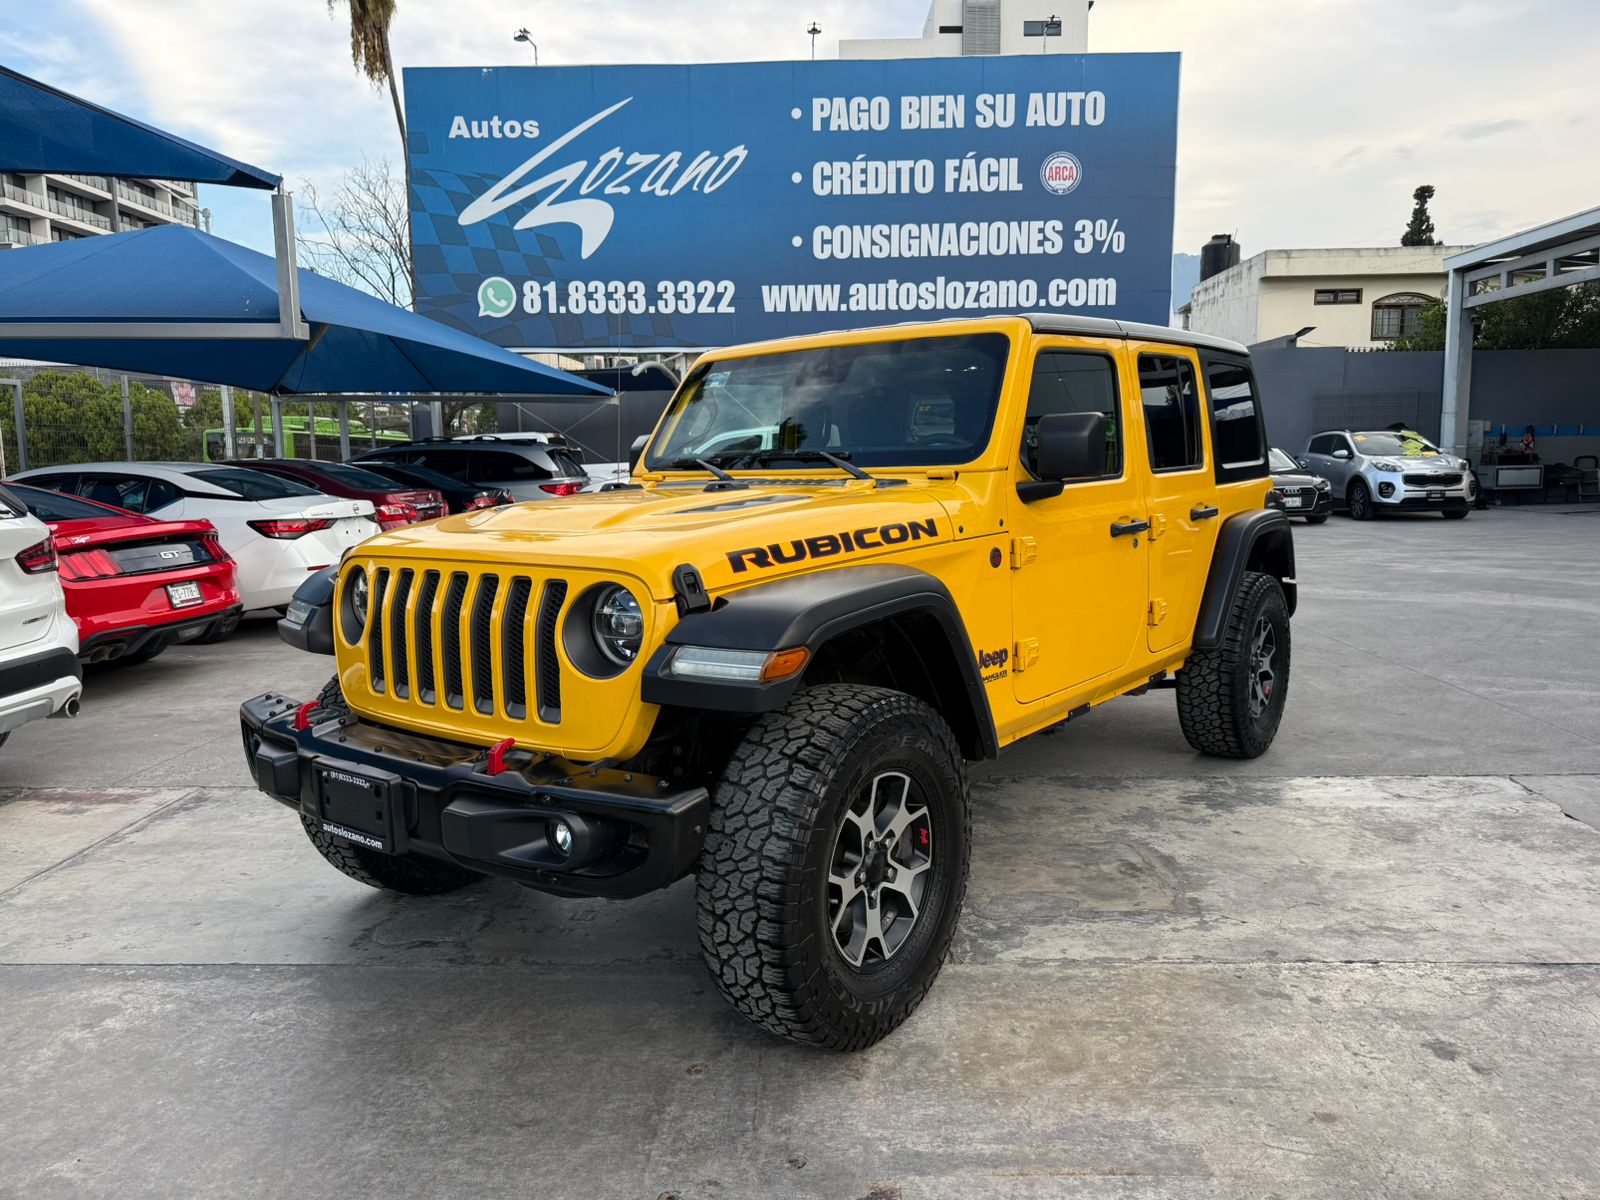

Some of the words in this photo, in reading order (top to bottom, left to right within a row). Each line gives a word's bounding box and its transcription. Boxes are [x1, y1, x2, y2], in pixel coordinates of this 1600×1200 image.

[448, 115, 540, 139] Autos
[812, 97, 890, 131] PAGO
[900, 94, 965, 130] BIEN
[975, 93, 1015, 129] SU
[1025, 91, 1106, 127] AUTO
[458, 96, 748, 260] Lozano
[812, 154, 934, 196] CRÉDITO
[945, 151, 1023, 193] FÁCIL
[1047, 165, 1075, 182] ARCA
[812, 220, 1063, 260] CONSIGNACIONES
[1073, 218, 1126, 254] 3%
[522, 279, 736, 315] 81.8333.3322
[761, 276, 1117, 313] www.autoslozano.com
[160, 550, 180, 559] GT
[726, 518, 939, 574] RUBICON
[978, 648, 1008, 669] Jeep
[322, 823, 383, 850] autoslozano.com
